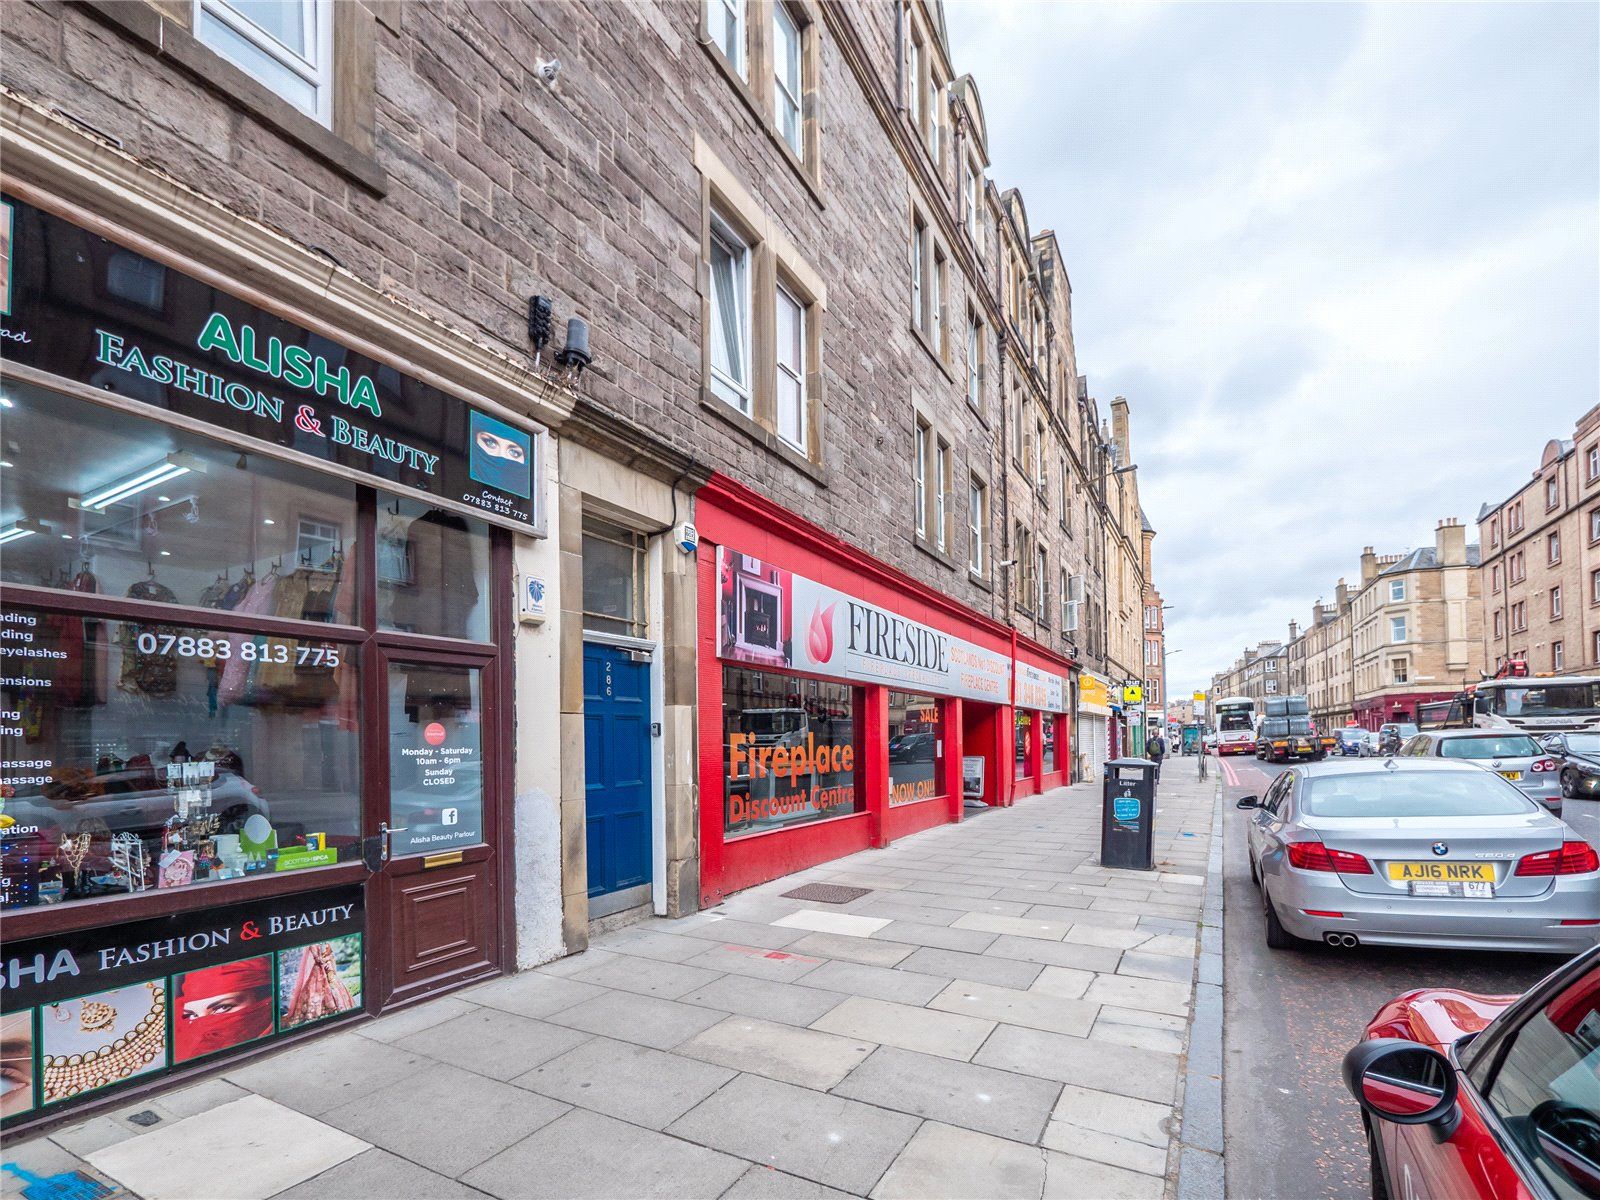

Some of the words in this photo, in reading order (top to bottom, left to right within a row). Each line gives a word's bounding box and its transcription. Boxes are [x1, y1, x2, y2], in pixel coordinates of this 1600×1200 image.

[198, 312, 381, 417] ALISHA
[95, 328, 285, 422] FASHION
[295, 405, 325, 437] &
[331, 415, 439, 475] BEAUTY
[463, 493, 491, 508] 07883
[495, 504, 510, 515] 813
[513, 510, 528, 520] 775
[482, 490, 513, 507] Contact
[847, 601, 949, 673] FIRESIDE
[0, 647, 68, 659] eyelashes
[137, 632, 232, 660] 07883
[240, 641, 288, 663] 813
[296, 646, 340, 668] 775
[920, 707, 939, 723] SALE
[402, 748, 434, 757] Monday
[440, 747, 473, 756] Saturday
[730, 732, 854, 787] Fireplace
[0, 760, 52, 769] assage
[416, 757, 437, 765] 10am
[444, 757, 461, 765] 6pm
[0, 776, 53, 785] assage
[425, 768, 453, 777] Sunday
[423, 777, 455, 786] CLOSED
[892, 783, 914, 803] NOW
[729, 790, 807, 824] Discount
[811, 784, 854, 809] Centre
[410, 835, 431, 844] Alisha
[432, 833, 453, 842] Beauty
[455, 830, 476, 838] Parlour
[1403, 864, 1441, 878] AJ16
[1448, 865, 1483, 879] NRK
[1468, 881, 1486, 890] 677
[0, 949, 80, 990] HA
[98, 927, 231, 972] FASHION
[239, 920, 263, 941] &
[268, 903, 354, 936] BEAUTY
